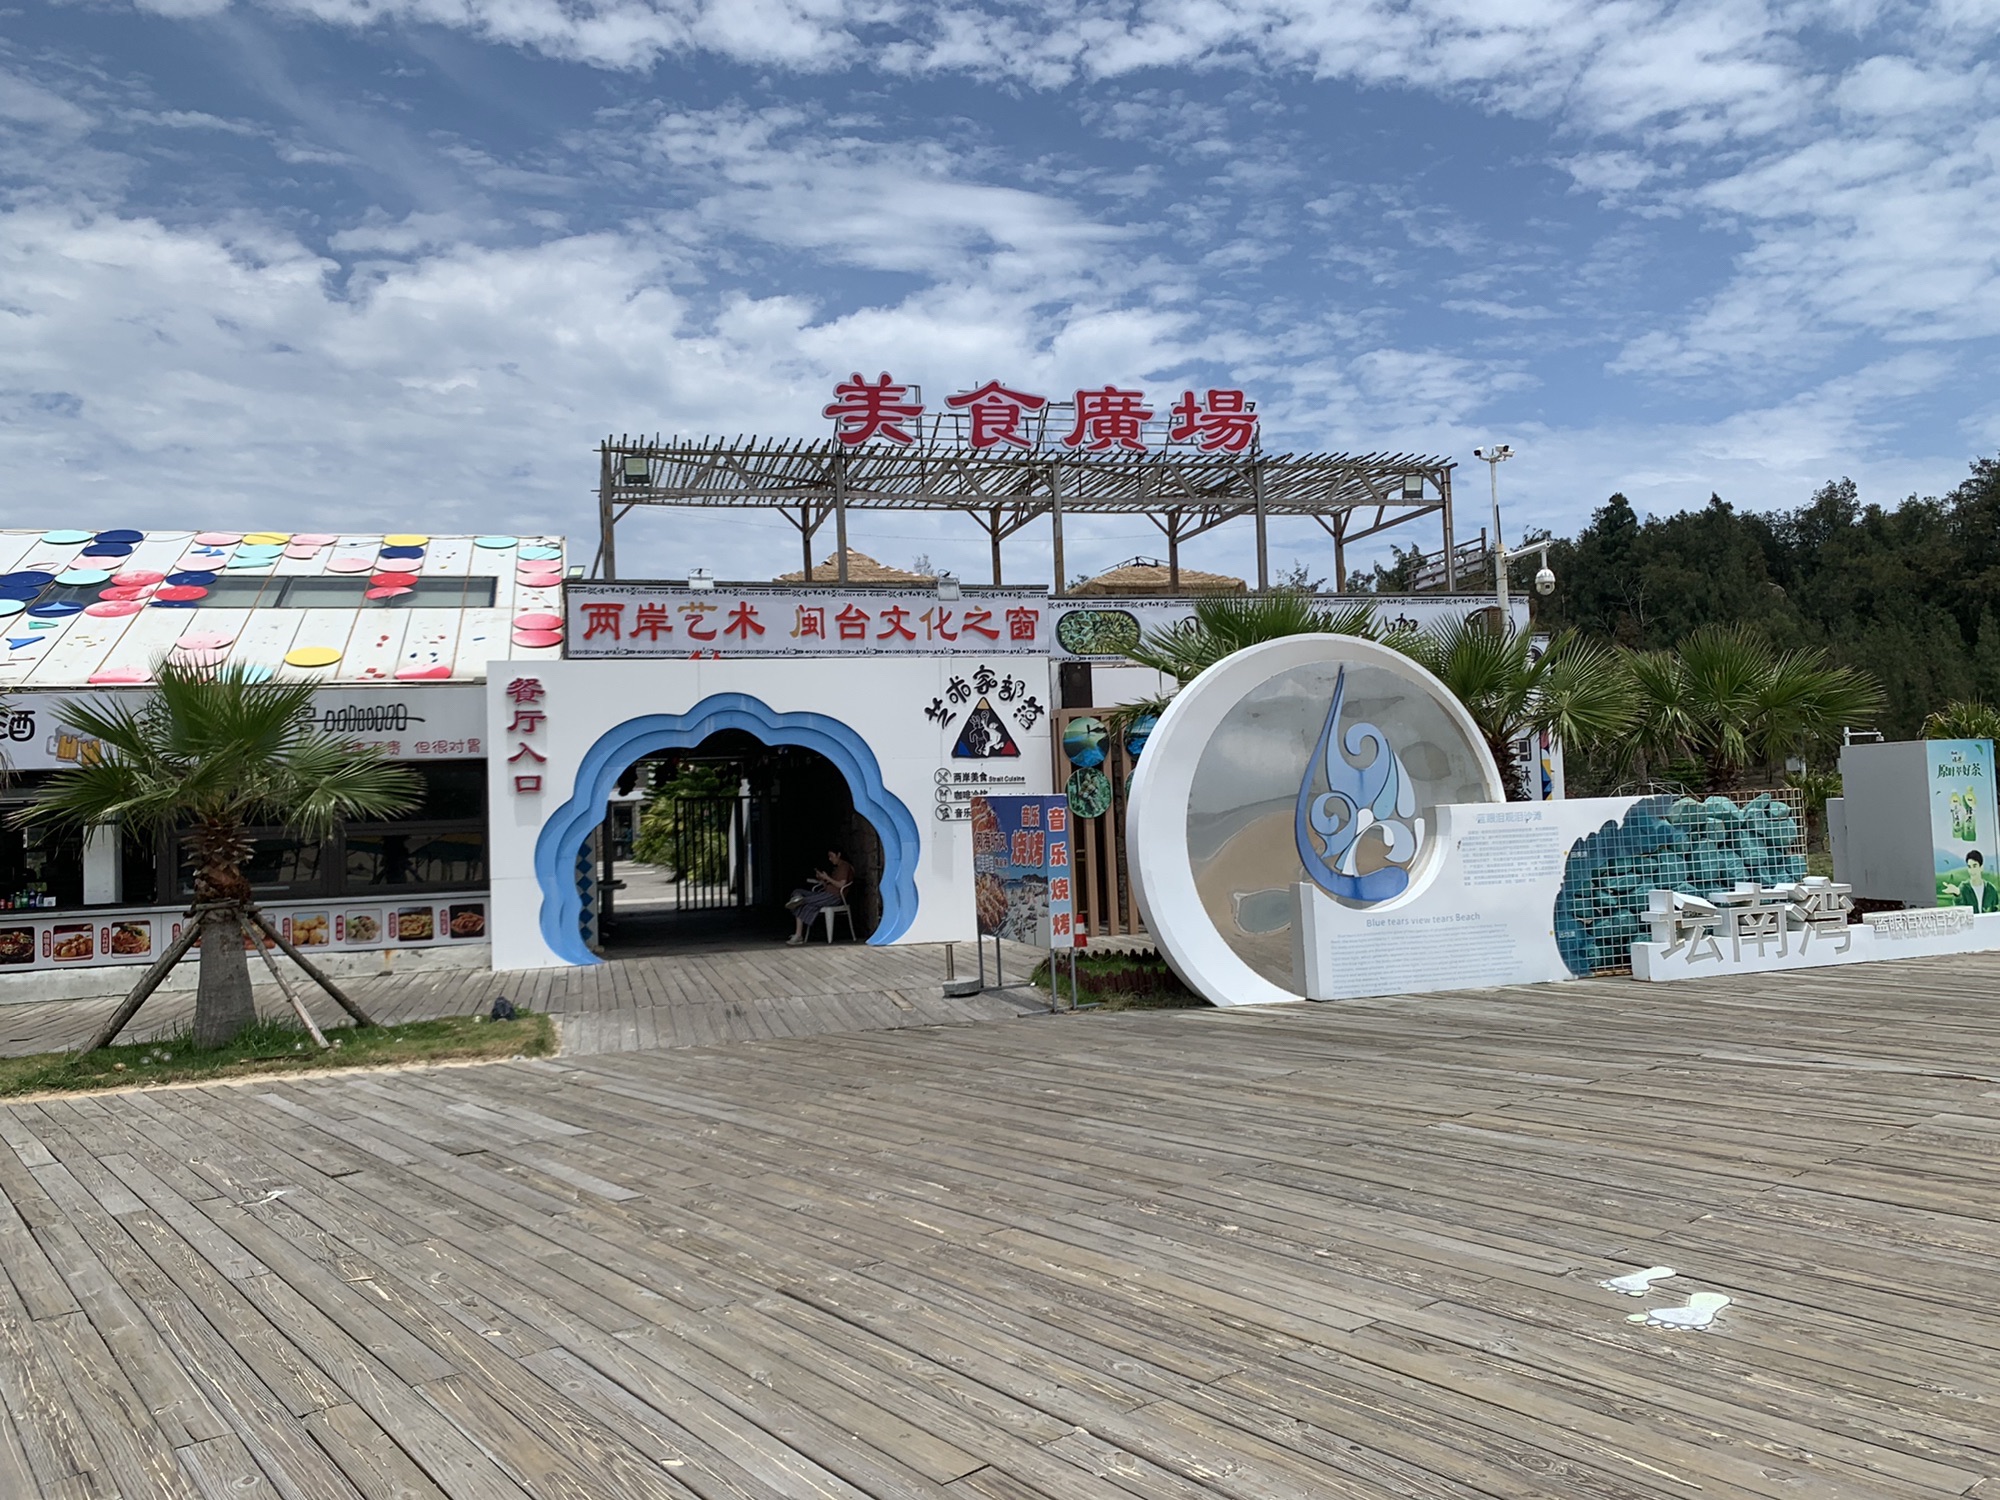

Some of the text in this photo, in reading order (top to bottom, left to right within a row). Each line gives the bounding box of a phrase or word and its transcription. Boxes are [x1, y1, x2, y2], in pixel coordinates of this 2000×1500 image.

[823, 371, 1259, 454] 美食廣場
[580, 602, 1040, 642] 两岸艺术 闽台文化之窗
[414, 738, 481, 754] 但很对胃
[506, 676, 548, 794] 餐厅入口
[953, 772, 988, 783] 两岸美食
[1021, 805, 1040, 828] 音乐
[1011, 830, 1046, 868] 烧烤
[1047, 807, 1070, 936] 音乐烧烤
[1366, 912, 1480, 928] Blue tears view tears Beach
[1641, 877, 1854, 962] 坛南湾
